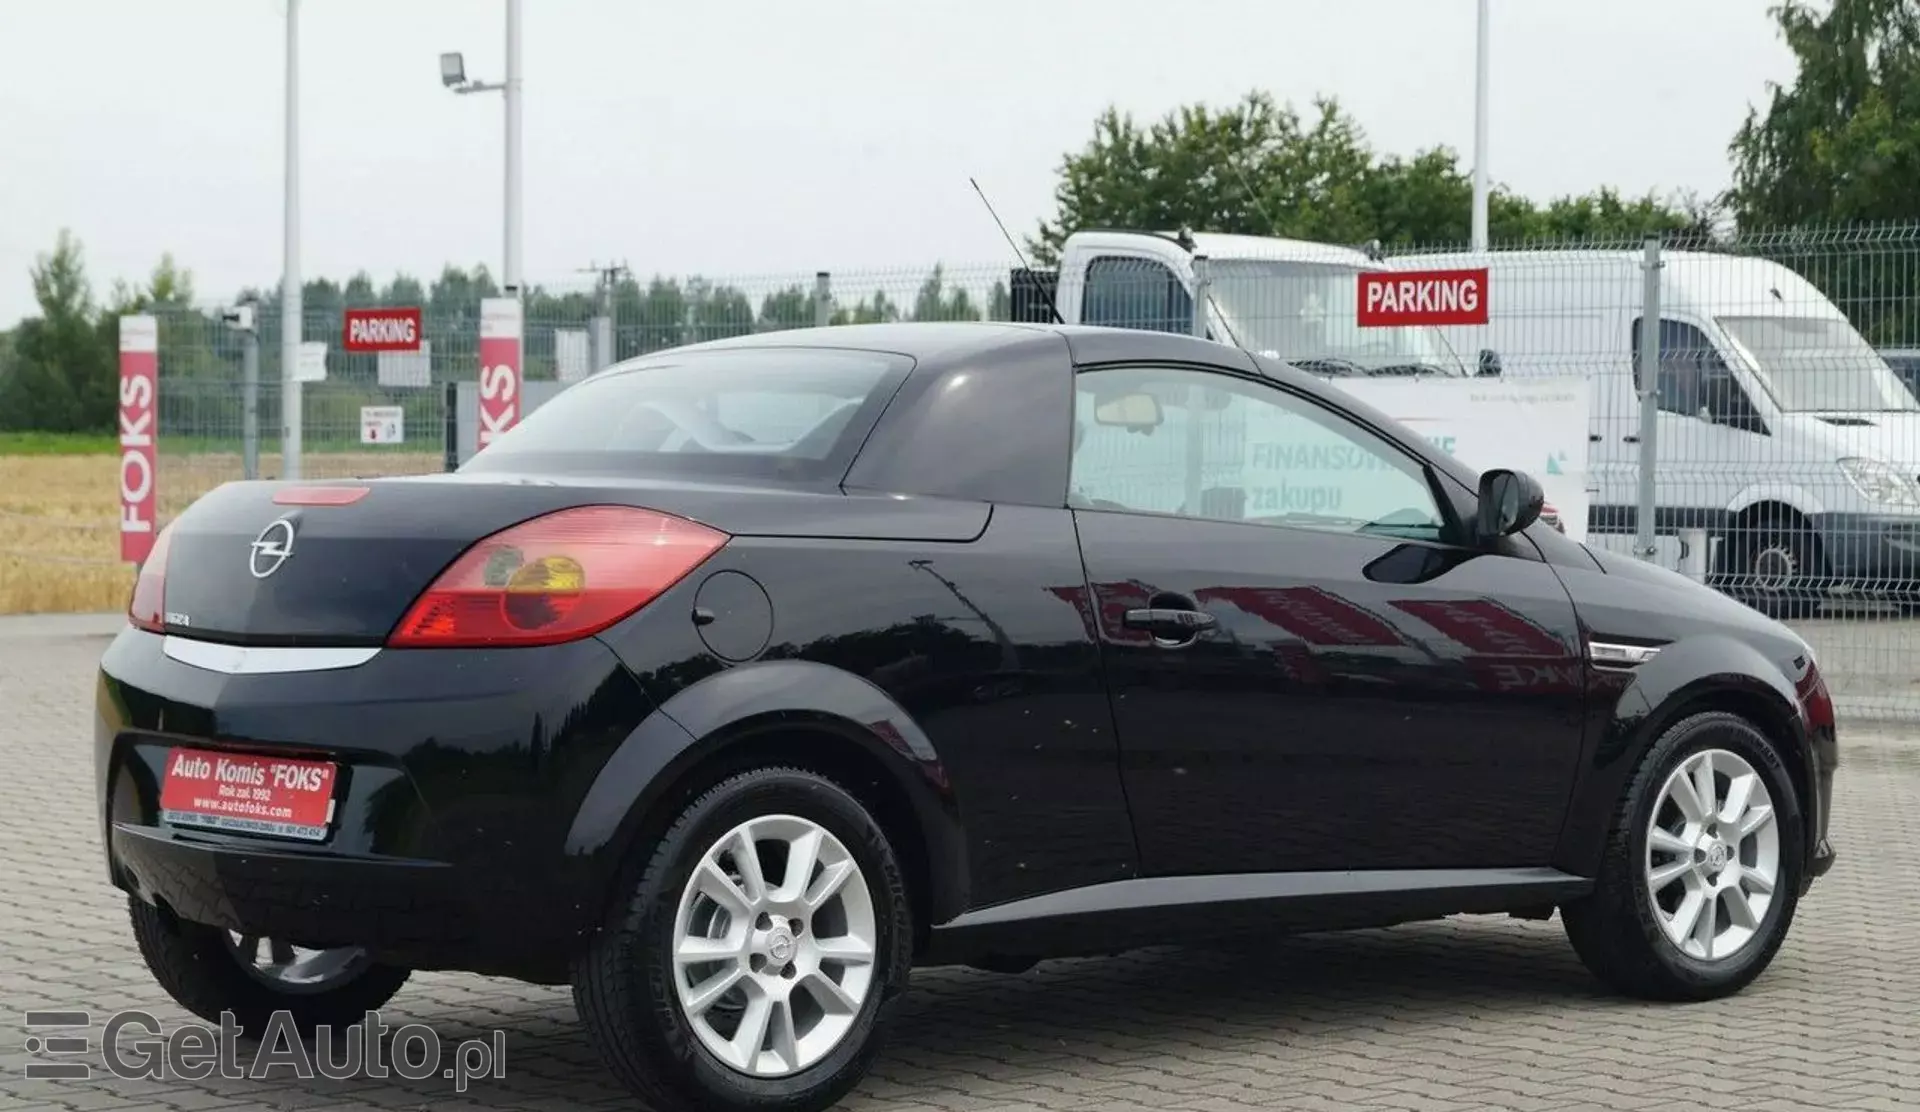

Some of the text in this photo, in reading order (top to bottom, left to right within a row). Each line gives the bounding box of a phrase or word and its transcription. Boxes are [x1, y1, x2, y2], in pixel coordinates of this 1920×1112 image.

[1366, 278, 1478, 313] PARKING
[349, 316, 416, 344] PARKING
[120, 374, 152, 533] FOKS
[1252, 478, 1342, 512] zakupu
[172, 754, 330, 792] Auto Komis "FOKS"
[193, 798, 292, 817] www.autofoks.com
[218, 784, 236, 797] Rok
[251, 788, 272, 801] 1992
